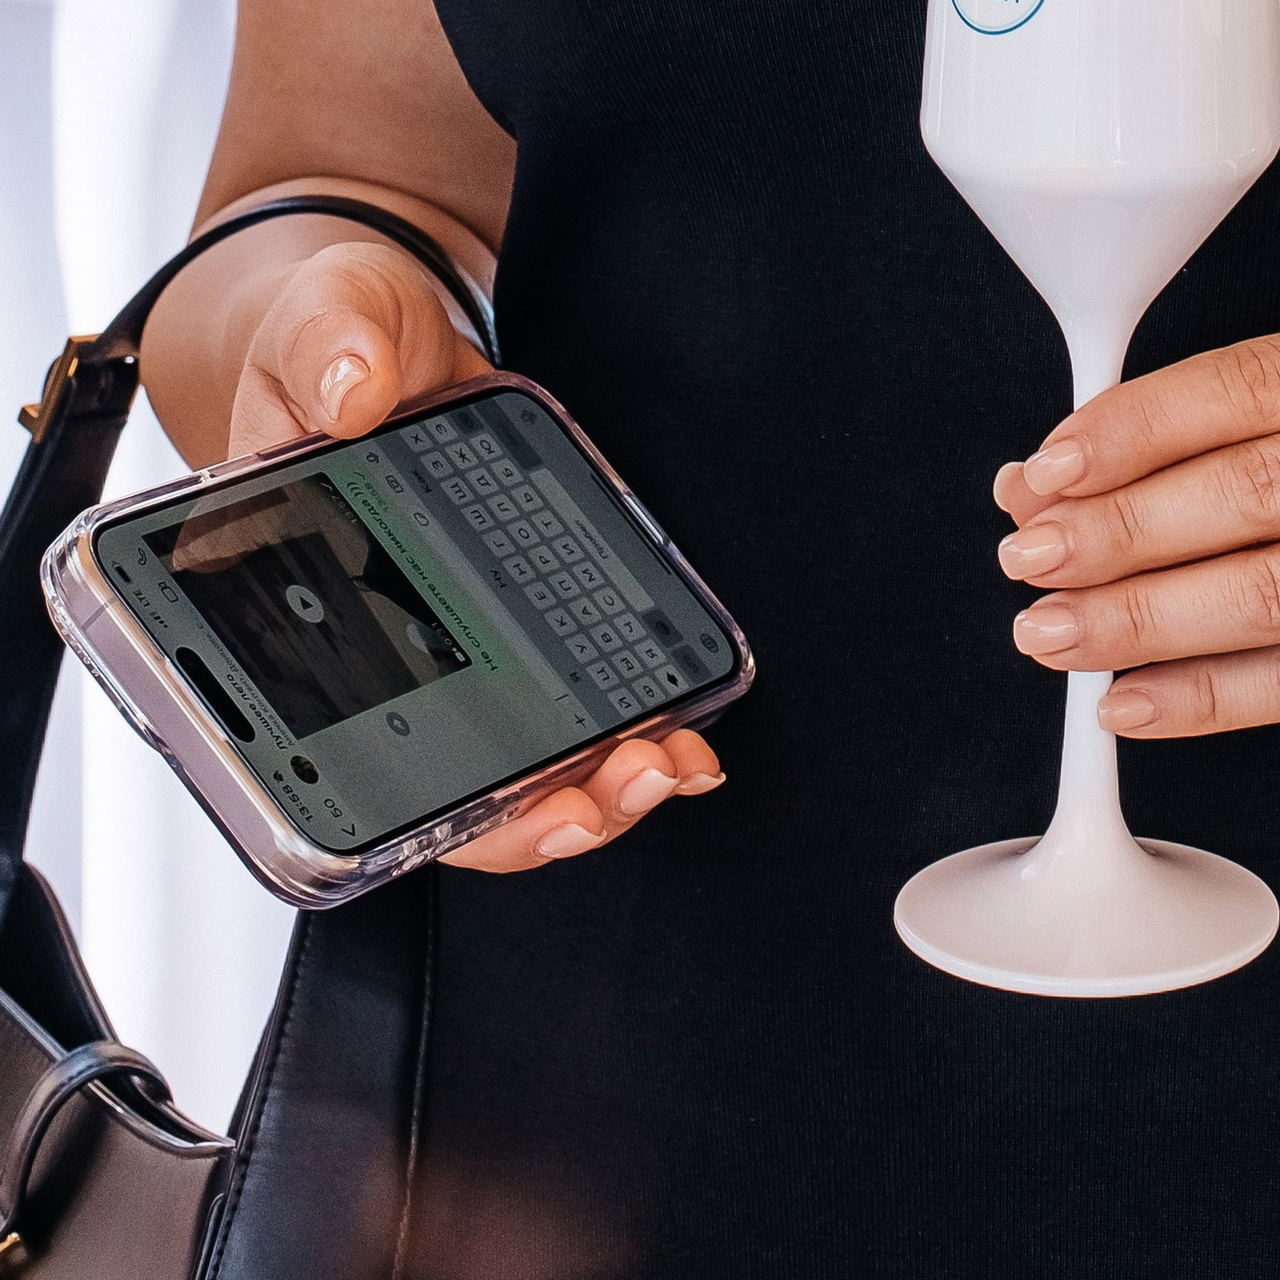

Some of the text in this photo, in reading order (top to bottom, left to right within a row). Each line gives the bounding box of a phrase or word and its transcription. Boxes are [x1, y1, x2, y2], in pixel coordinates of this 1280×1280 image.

[410, 468, 432, 493] Как
[361, 498, 407, 554] никогда
[574, 519, 609, 559] Пробел
[405, 555, 428, 580] нас
[132, 588, 150, 607] LTE
[426, 582, 480, 648] слушаете
[430, 621, 452, 646] 0:31
[480, 650, 498, 671] Не
[225, 673, 288, 750] Лучшее лето
[281, 783, 313, 822] 13:58
[323, 797, 343, 818] 50
